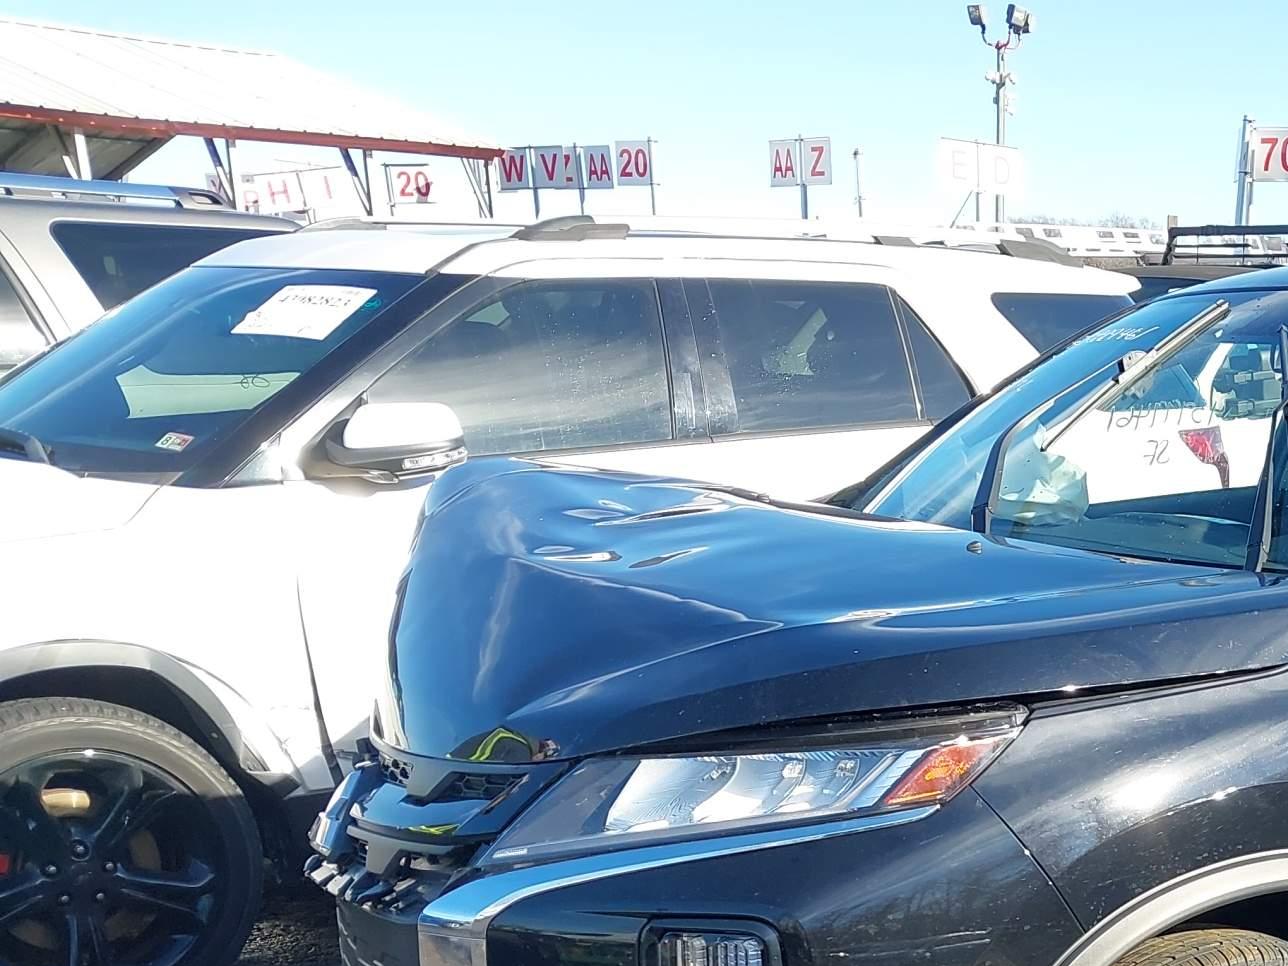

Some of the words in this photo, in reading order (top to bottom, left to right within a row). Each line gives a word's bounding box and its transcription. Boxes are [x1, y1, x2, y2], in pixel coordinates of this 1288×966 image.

[501, 154, 524, 183] W
[540, 153, 557, 181] V
[589, 153, 611, 182] AA
[619, 148, 648, 178] 20
[773, 148, 795, 178] AA
[810, 146, 826, 177] Z
[267, 179, 291, 205] H
[397, 170, 431, 198] 20
